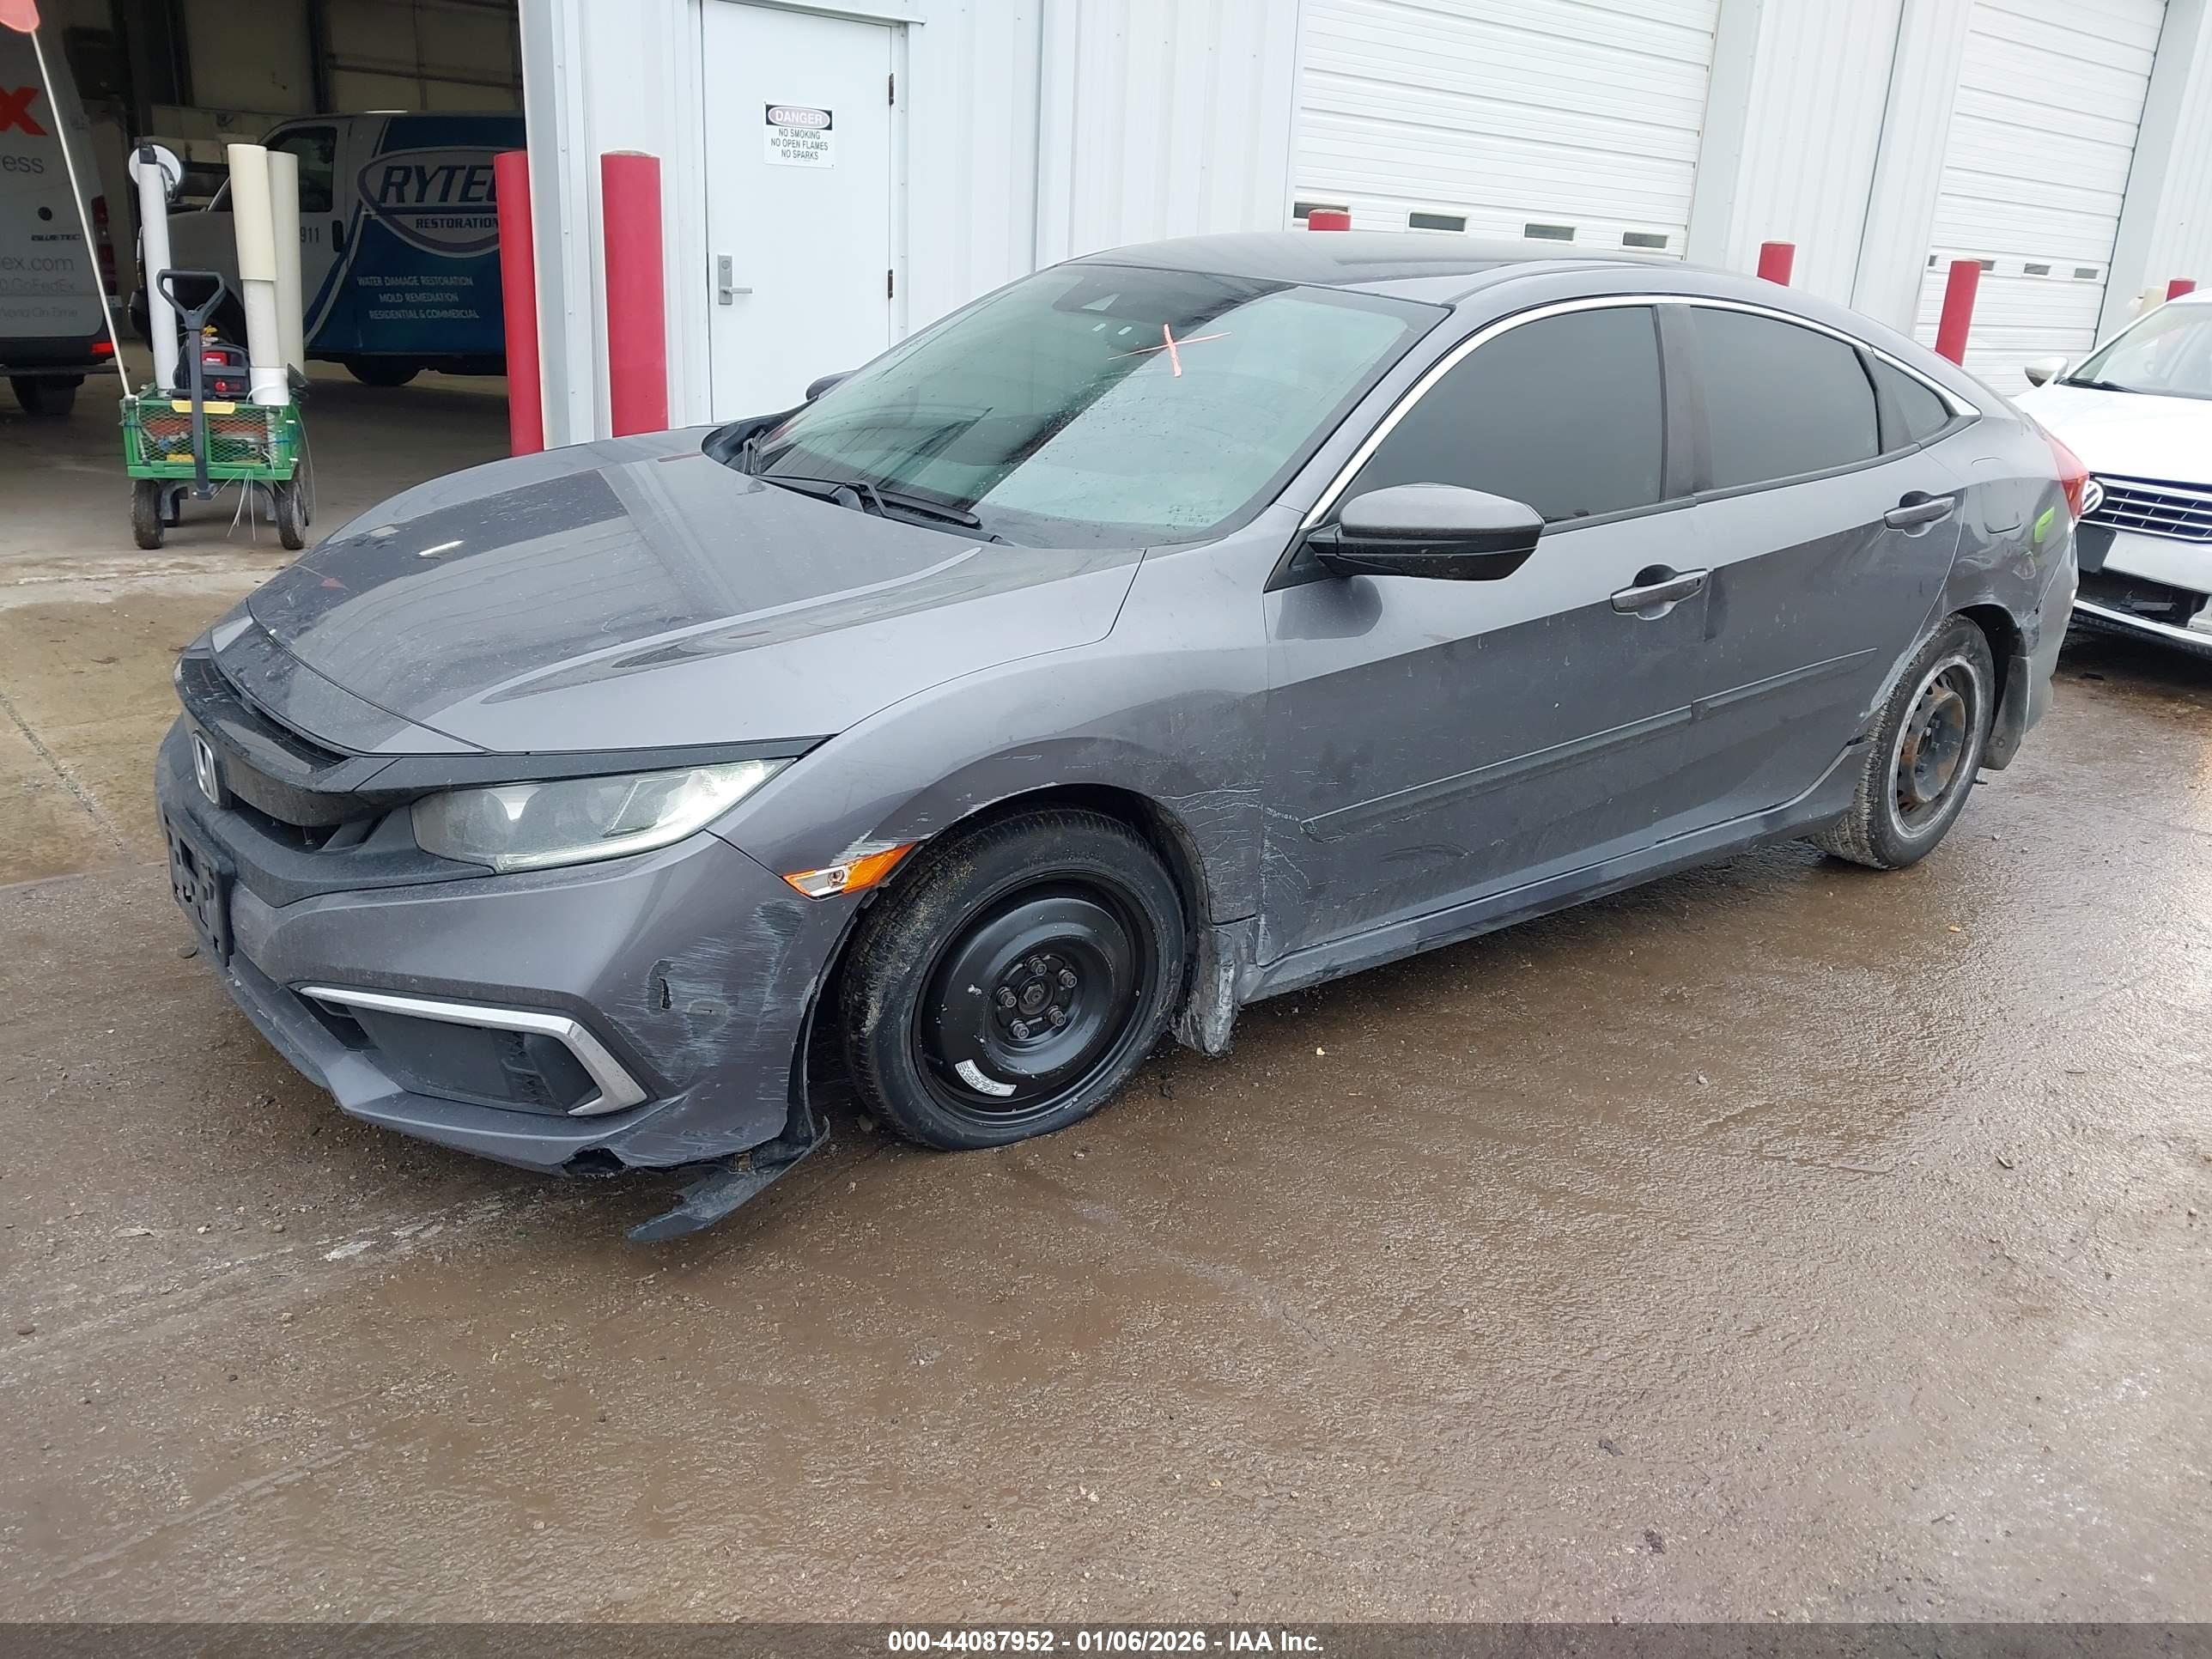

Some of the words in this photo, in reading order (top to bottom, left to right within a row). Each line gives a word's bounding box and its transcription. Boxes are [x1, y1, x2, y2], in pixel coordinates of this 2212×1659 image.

[775, 110, 823, 125] DANGER
[778, 128, 788, 137] NO
[790, 129, 820, 139] SMOKING
[770, 137, 781, 148] NO
[781, 138, 801, 149] OPEN
[802, 140, 829, 151] FLAMES
[781, 149, 791, 158] NO
[793, 149, 818, 160] SPARKS
[421, 276, 474, 287] RESTORATION
[404, 294, 459, 303] REMEDIATION
[368, 310, 419, 320] RESIDENTIAL
[427, 310, 480, 320] COMMERCIAL
